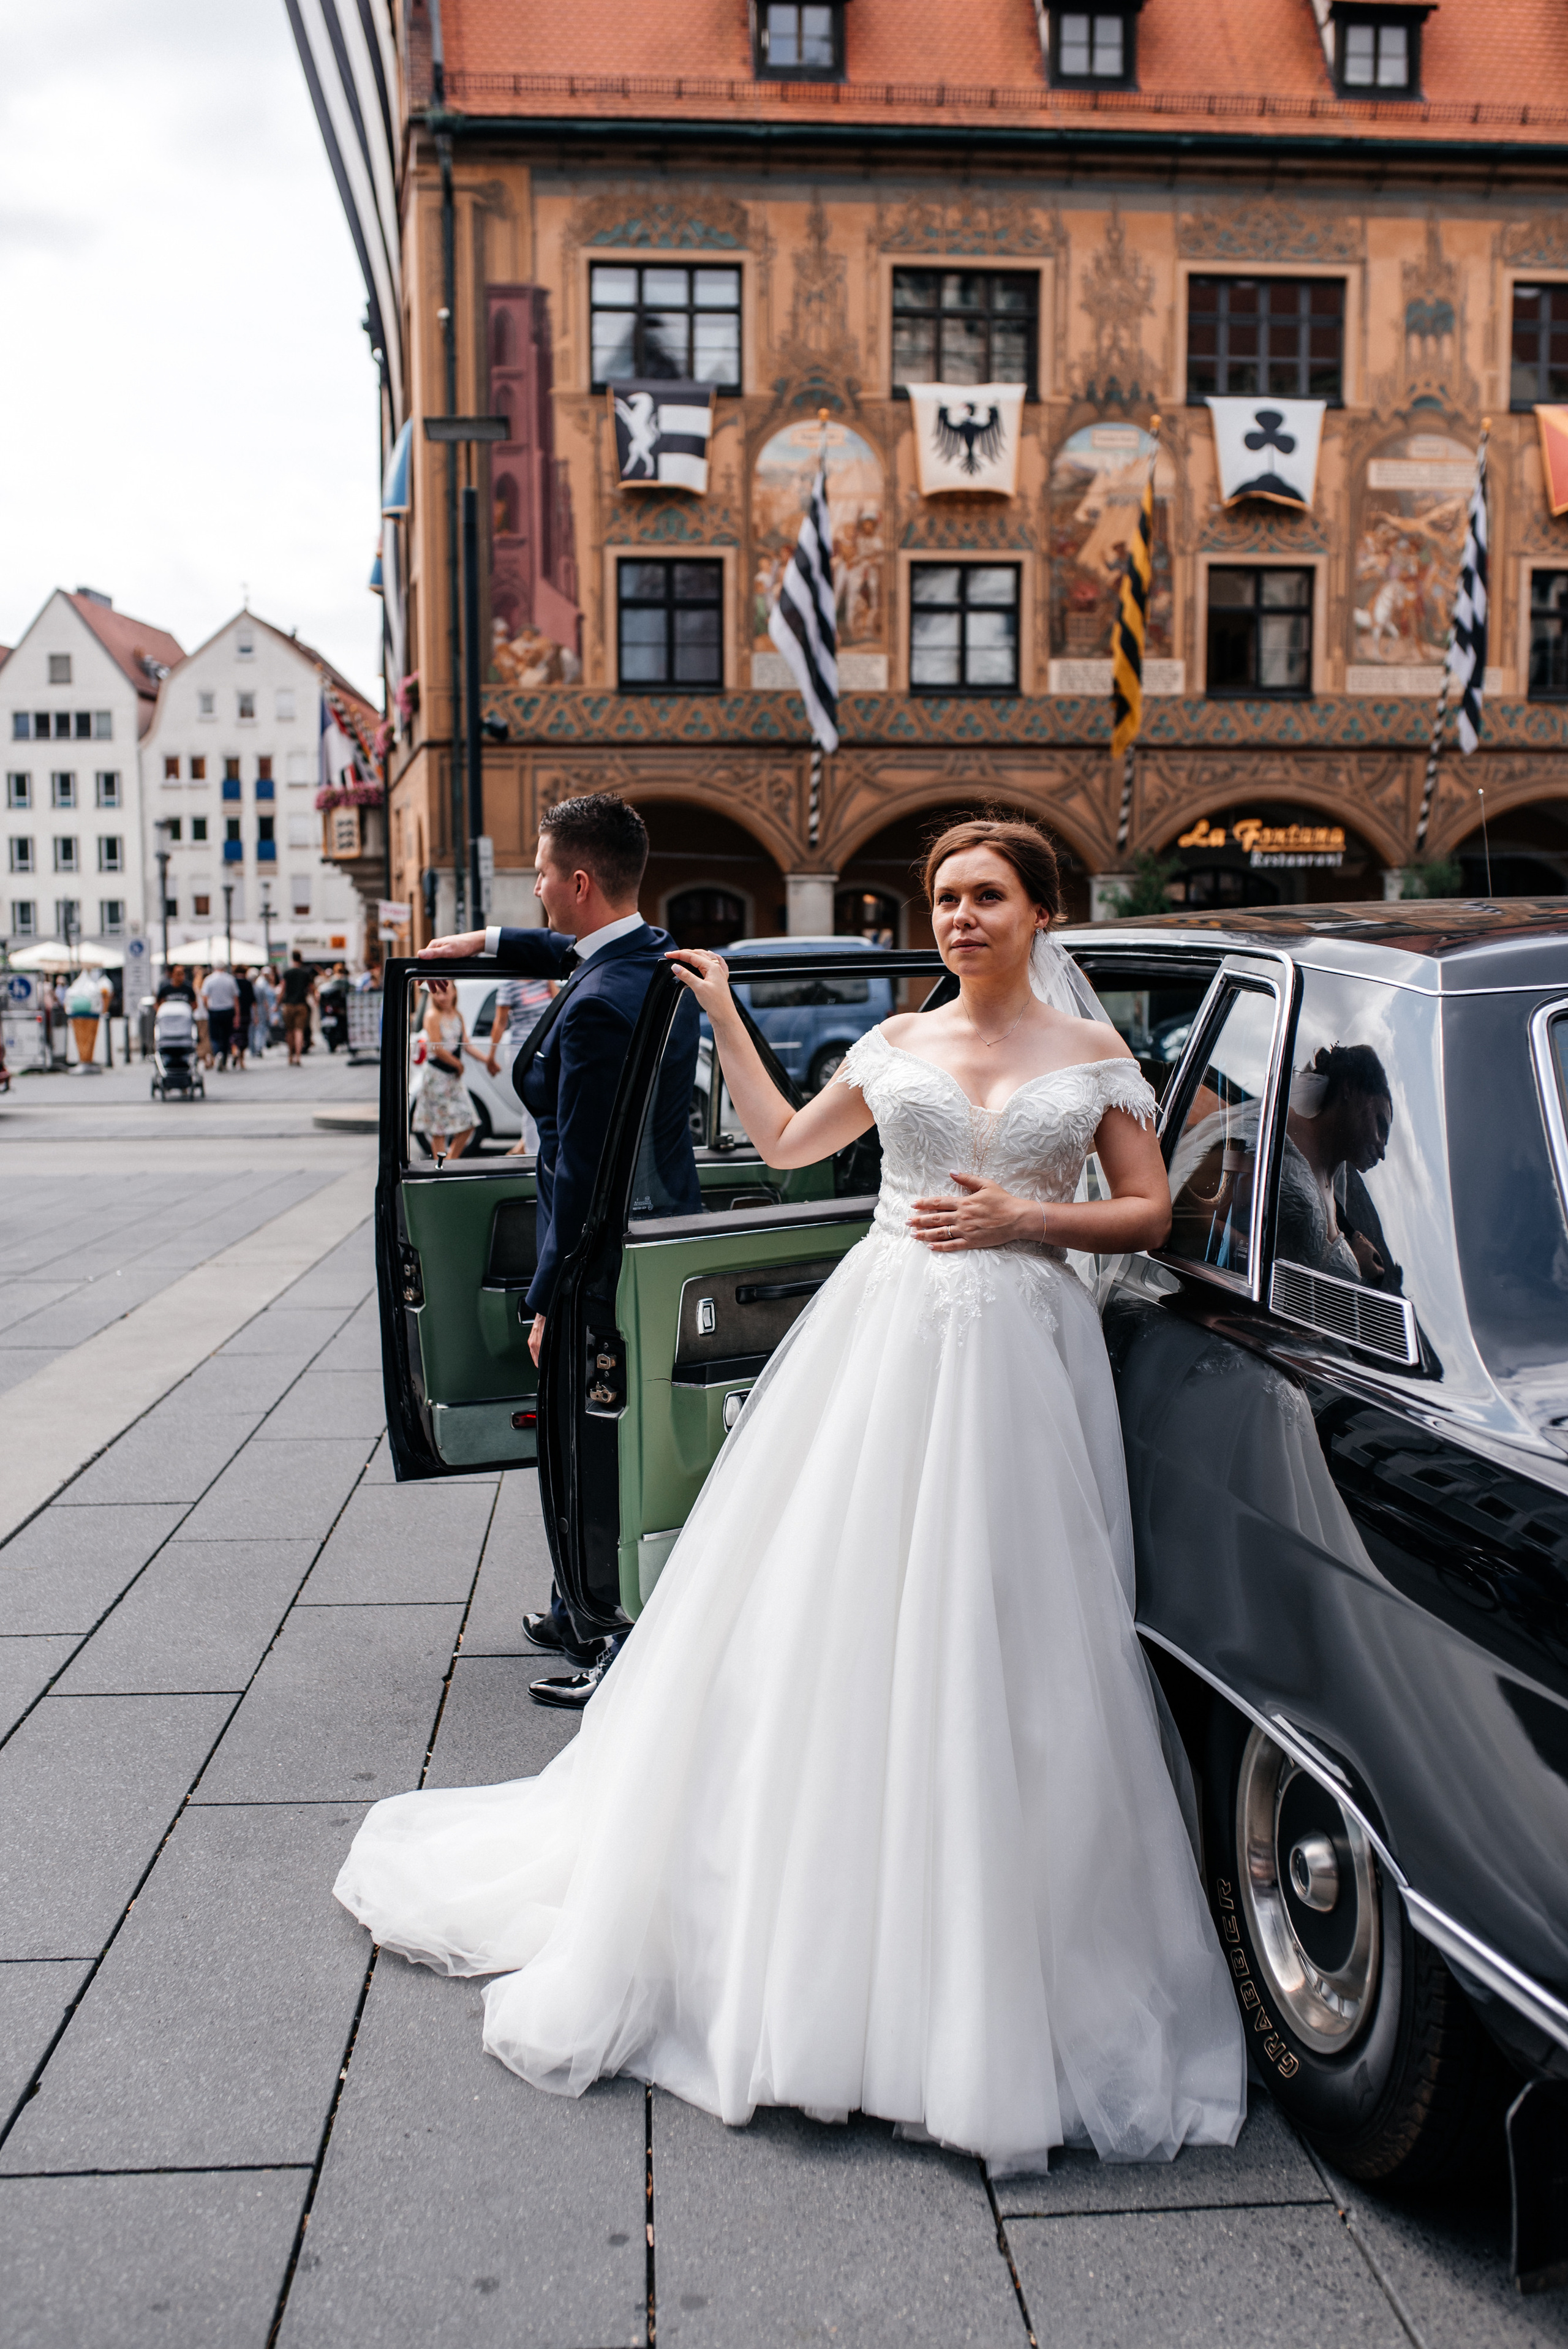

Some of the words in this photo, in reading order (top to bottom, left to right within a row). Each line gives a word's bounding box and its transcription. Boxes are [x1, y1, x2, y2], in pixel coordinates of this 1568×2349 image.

[1177, 818, 1226, 848] La
[1250, 851, 1343, 867] Restaurant
[1216, 1878, 1299, 2078] GRABBER
